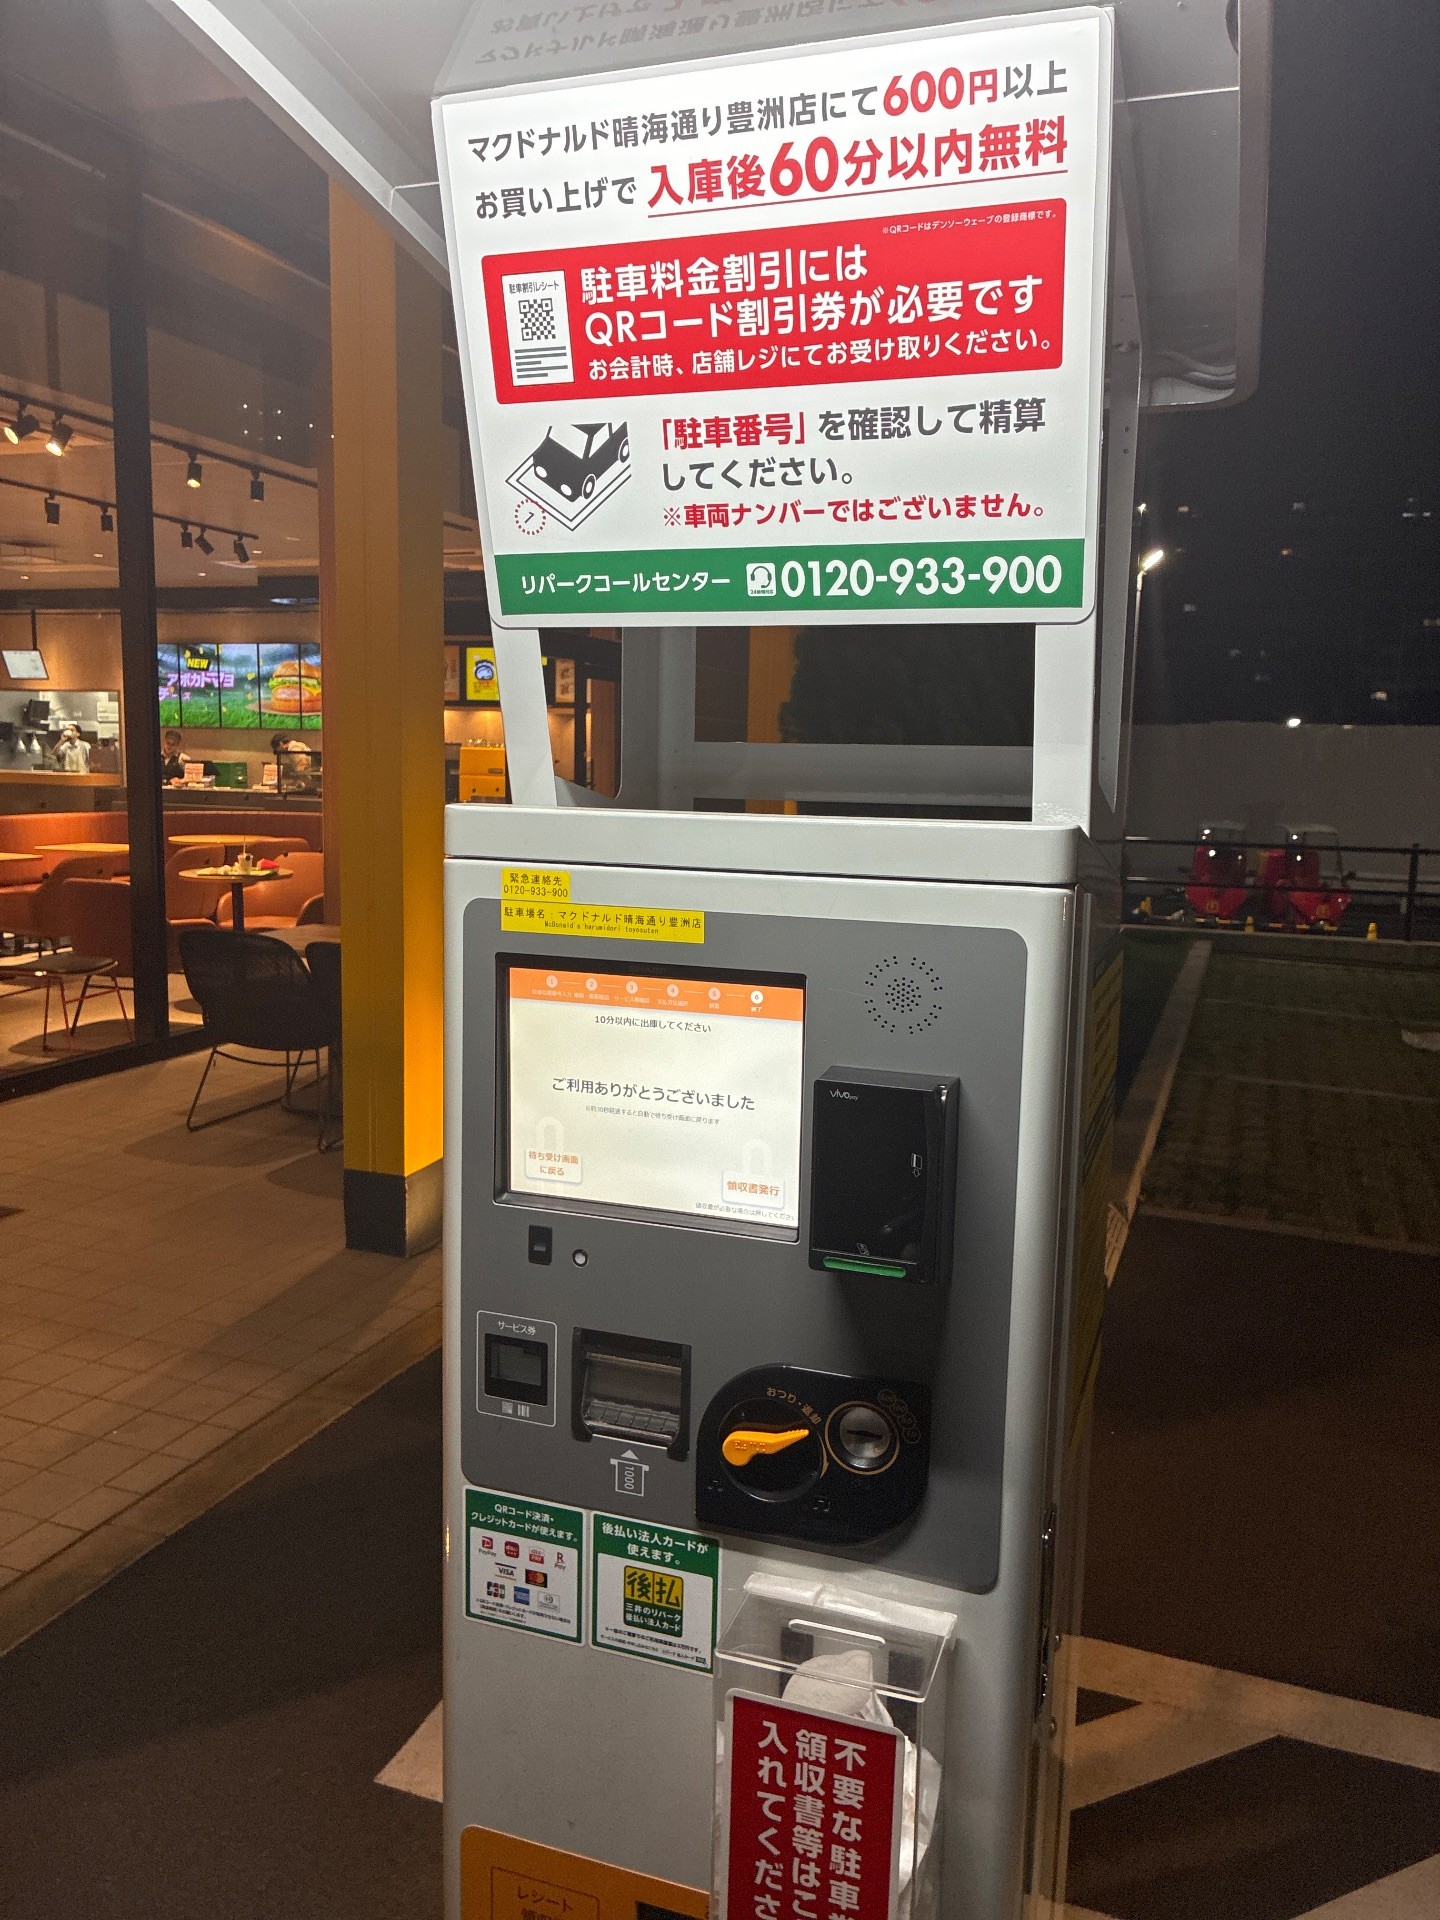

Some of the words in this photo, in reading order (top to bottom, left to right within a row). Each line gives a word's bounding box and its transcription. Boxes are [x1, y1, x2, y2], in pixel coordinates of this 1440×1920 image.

[467, 59, 1068, 163] マクドナルド晴海通り豊洲店にて600円以上
[475, 175, 638, 221] お買い上げで
[647, 115, 1068, 209] 入庫後60分以内無料
[581, 244, 868, 303] 駐車料金割引には
[509, 280, 560, 294] 駐車割引レシート
[584, 274, 1043, 346] QRコード割引券が必要です
[588, 326, 1052, 381] お会計時、店舗レジにてお受け取りください。
[661, 396, 1047, 451] 「駐車番号」を確認して精算
[662, 457, 854, 491] してください。
[662, 492, 1045, 529] ※車両ナンバーではございません。
[520, 572, 731, 596] リパークコールセンター
[780, 554, 1063, 598] 0120-933-900
[187, 658, 209, 669] NEW
[503, 885, 568, 898] 0120-933-900
[509, 872, 562, 886] 緊急連絡先
[625, 926, 659, 936] toyosuten
[594, 1015, 712, 1033] 10分以内に出庫してください
[552, 1076, 755, 1111] ご利用ありがとうございました
[528, 1150, 579, 1164] 待ち受け画面
[540, 1165, 565, 1176] に戻る
[726, 1180, 780, 1197] 領収書発行
[497, 1321, 536, 1336] サービス券
[624, 1465, 635, 1490] 1000
[470, 1511, 578, 1543] クレジットカードが使えます。
[601, 1521, 709, 1555] 後払い法人カードが
[627, 1542, 681, 1565] 使えます。
[498, 1567, 515, 1577] VISA
[626, 1570, 681, 1608] 後払
[625, 1602, 682, 1622] 三井のリパーク
[625, 1612, 682, 1632] 後払い法人カード
[791, 1728, 829, 1920] 領収書等はこ
[517, 1885, 573, 1913] レシート
